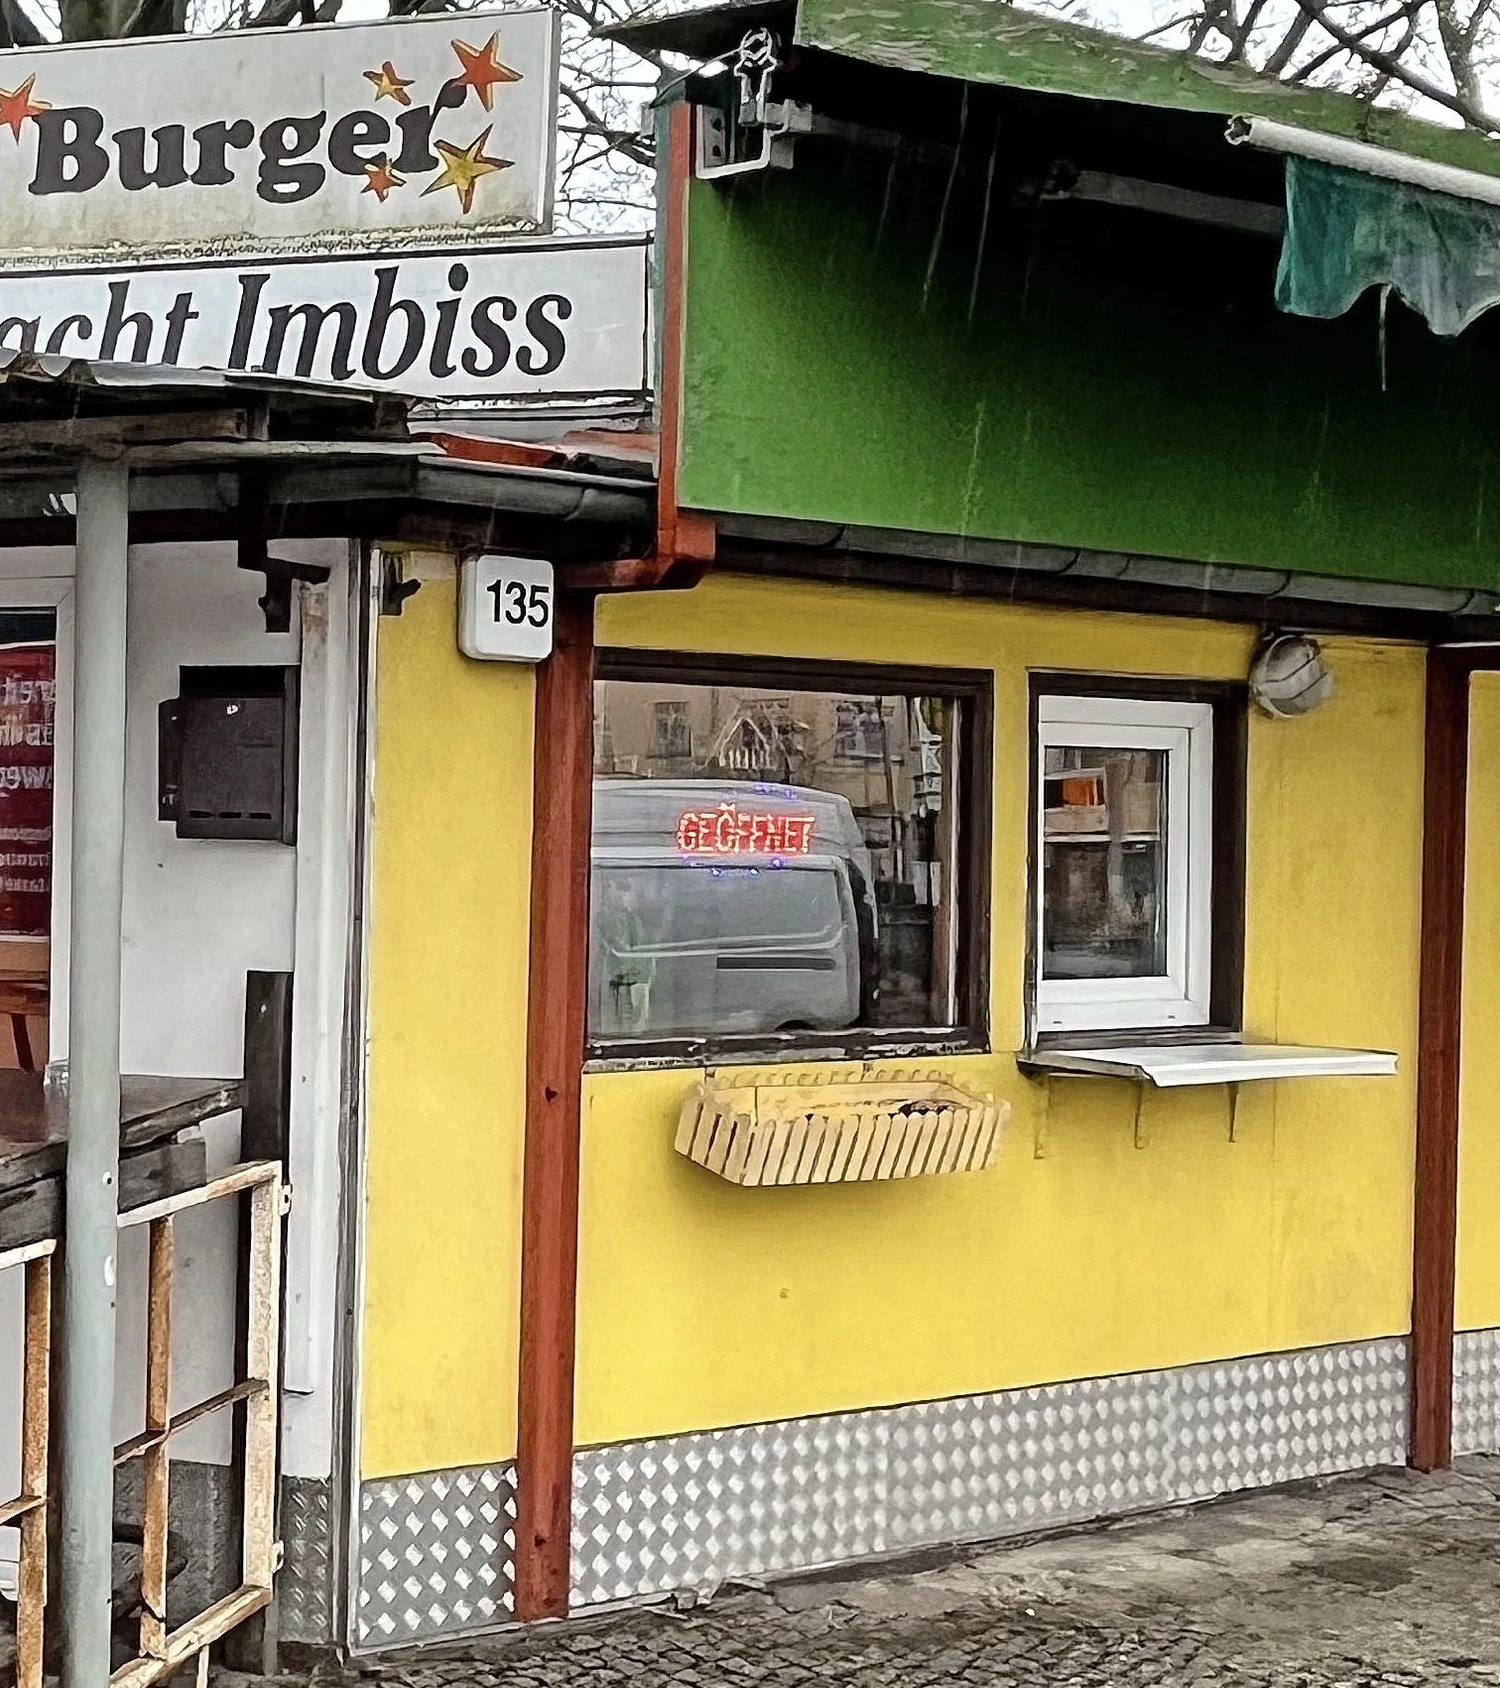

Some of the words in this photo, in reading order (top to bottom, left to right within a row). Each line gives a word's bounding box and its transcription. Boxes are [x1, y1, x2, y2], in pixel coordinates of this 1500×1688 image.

[29, 78, 466, 204] Burger
[230, 262, 574, 382] Imbiss
[487, 579, 549, 627] 135
[677, 802, 815, 853] GEÖFFNET
